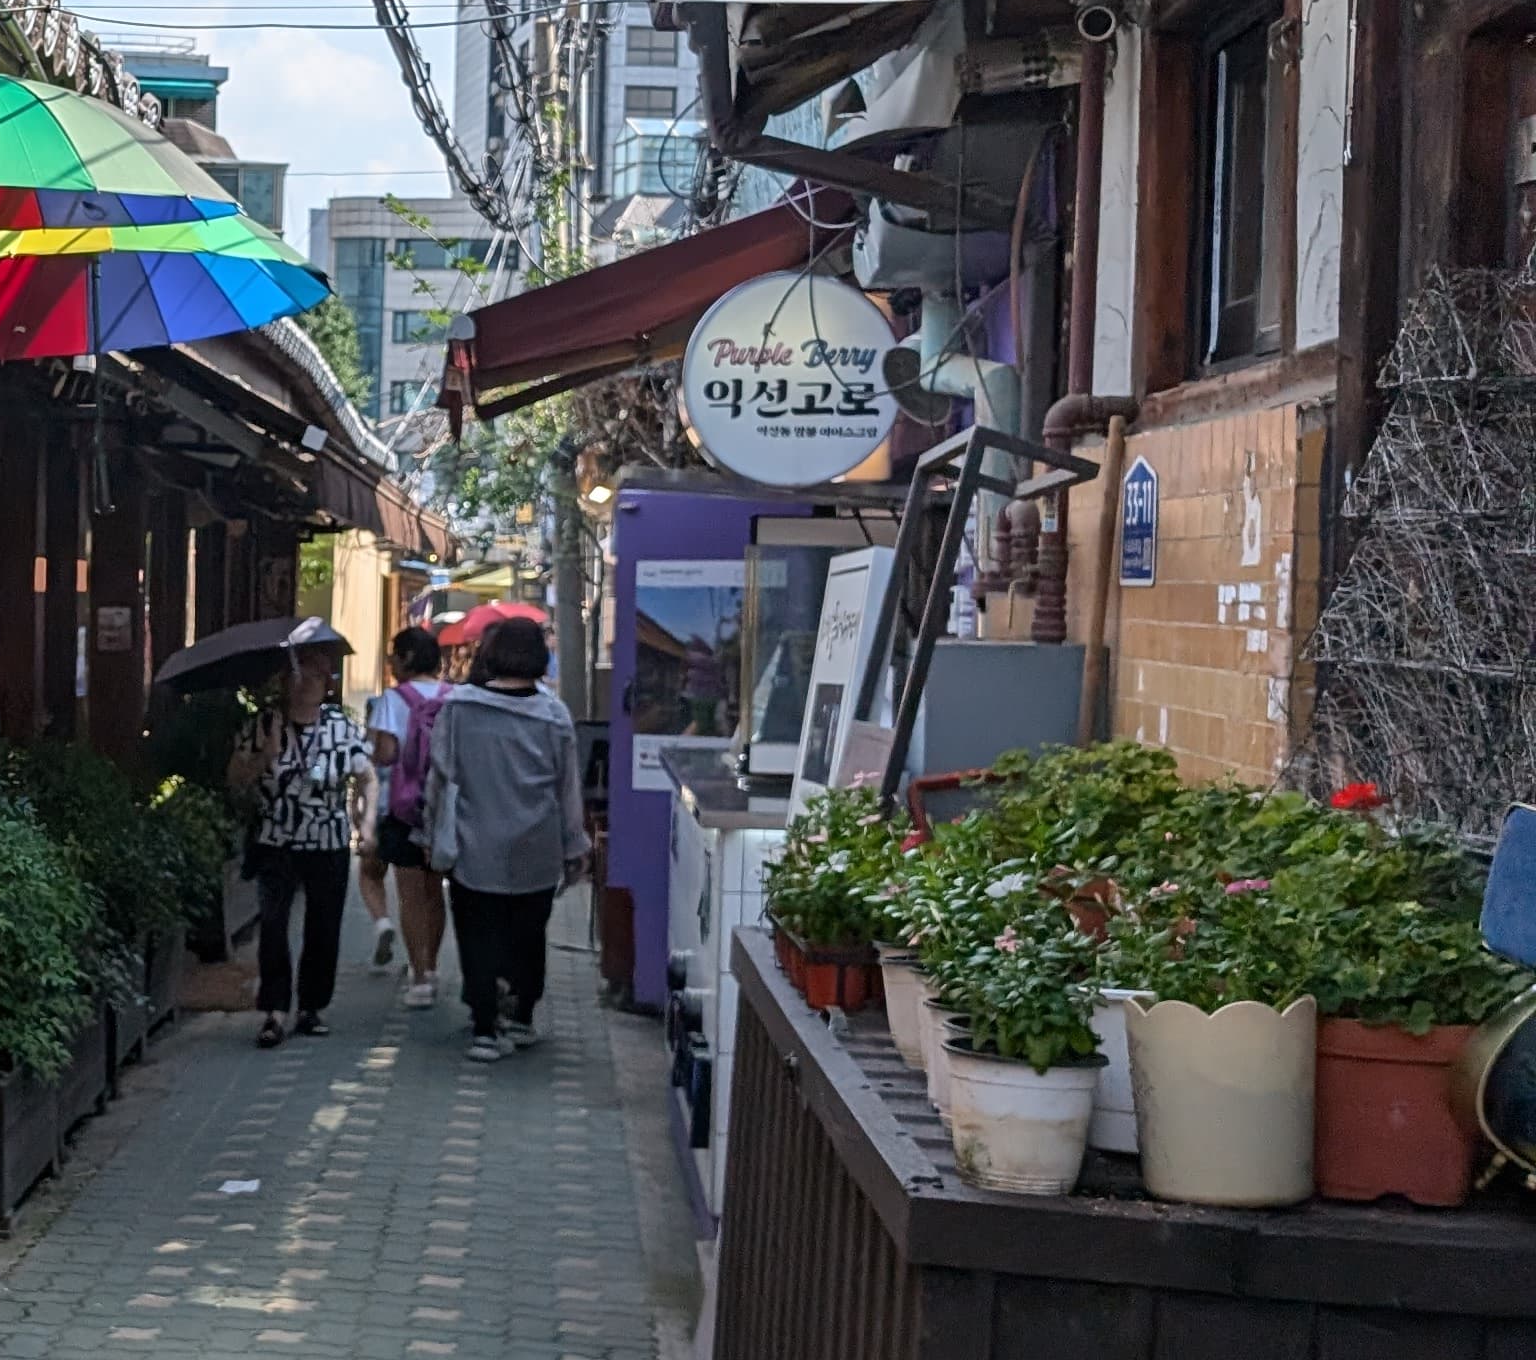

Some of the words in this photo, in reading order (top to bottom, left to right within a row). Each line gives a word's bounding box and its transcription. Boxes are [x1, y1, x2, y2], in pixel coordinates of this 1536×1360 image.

[707, 338, 794, 374] Purple
[800, 338, 877, 375] Berry
[703, 378, 881, 419] 익선고로
[1125, 480, 1152, 527] 33-11
